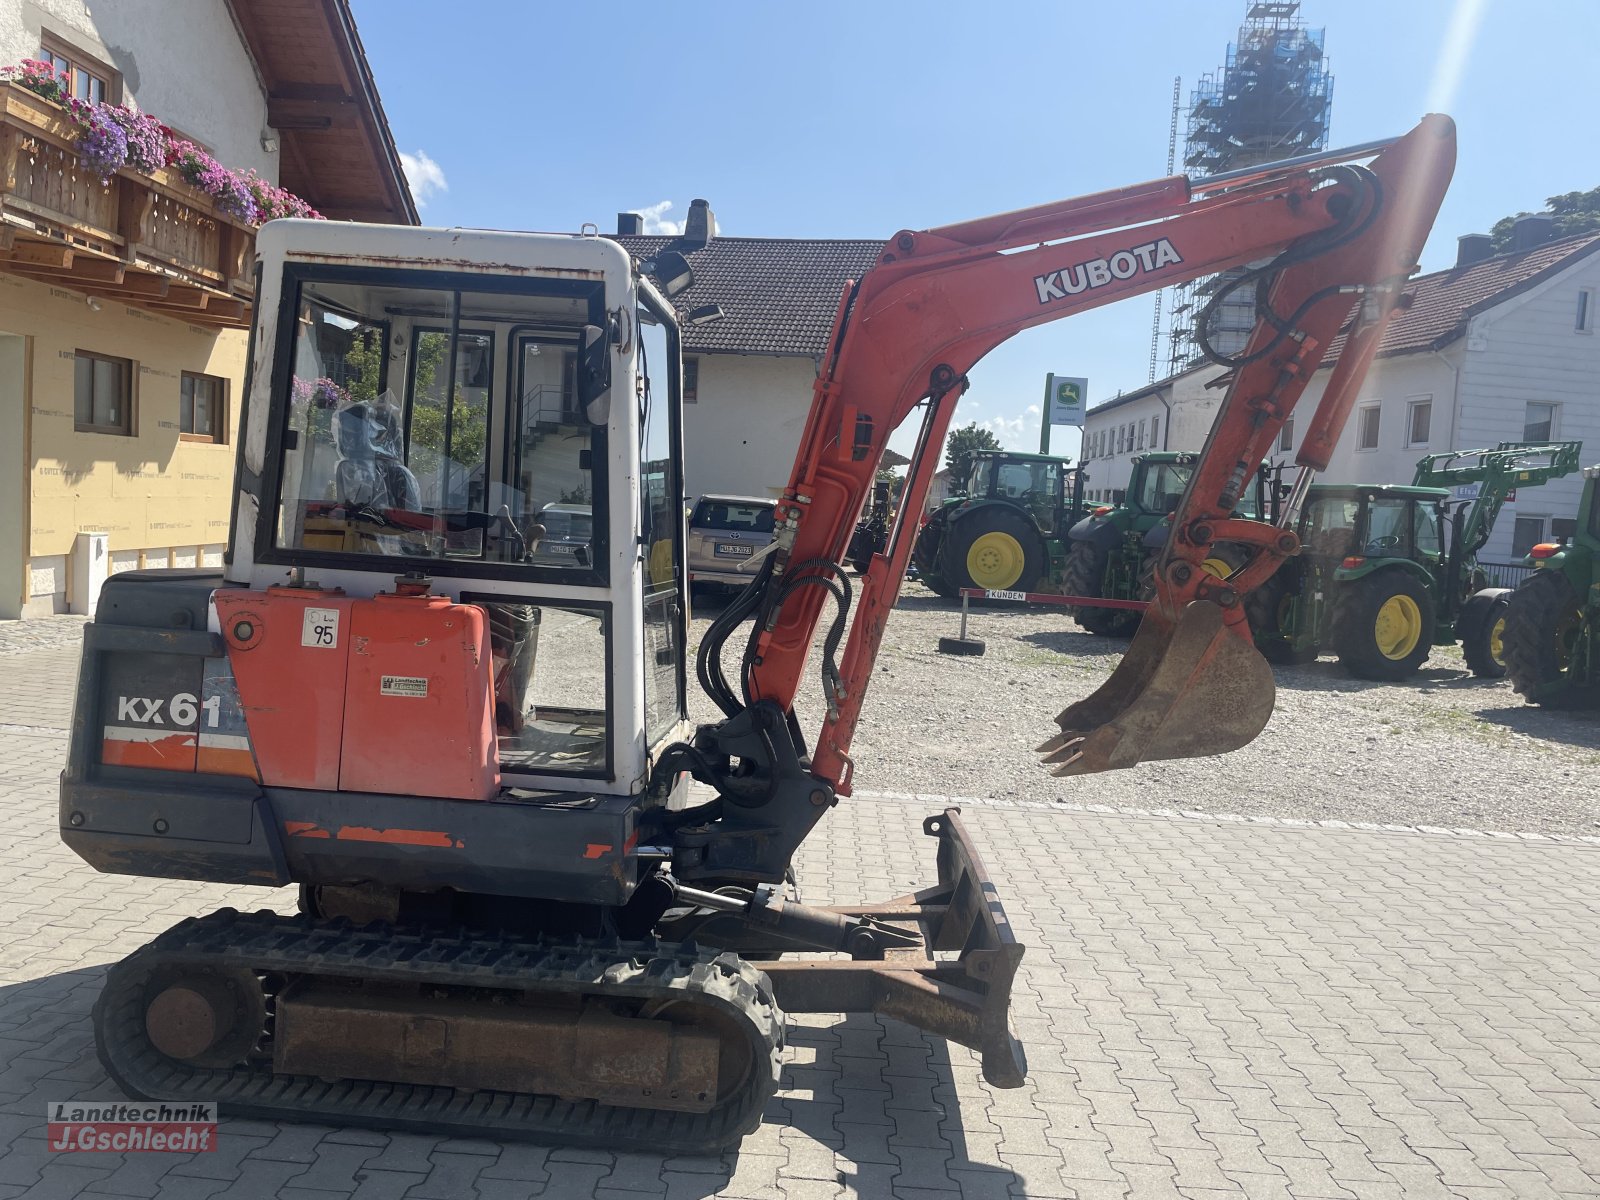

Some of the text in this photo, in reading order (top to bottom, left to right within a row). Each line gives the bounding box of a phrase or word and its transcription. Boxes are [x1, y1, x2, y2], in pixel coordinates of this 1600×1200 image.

[1034, 237, 1183, 304] KUBOTA
[991, 590, 1024, 600] KUNDEN
[314, 625, 334, 645] 95
